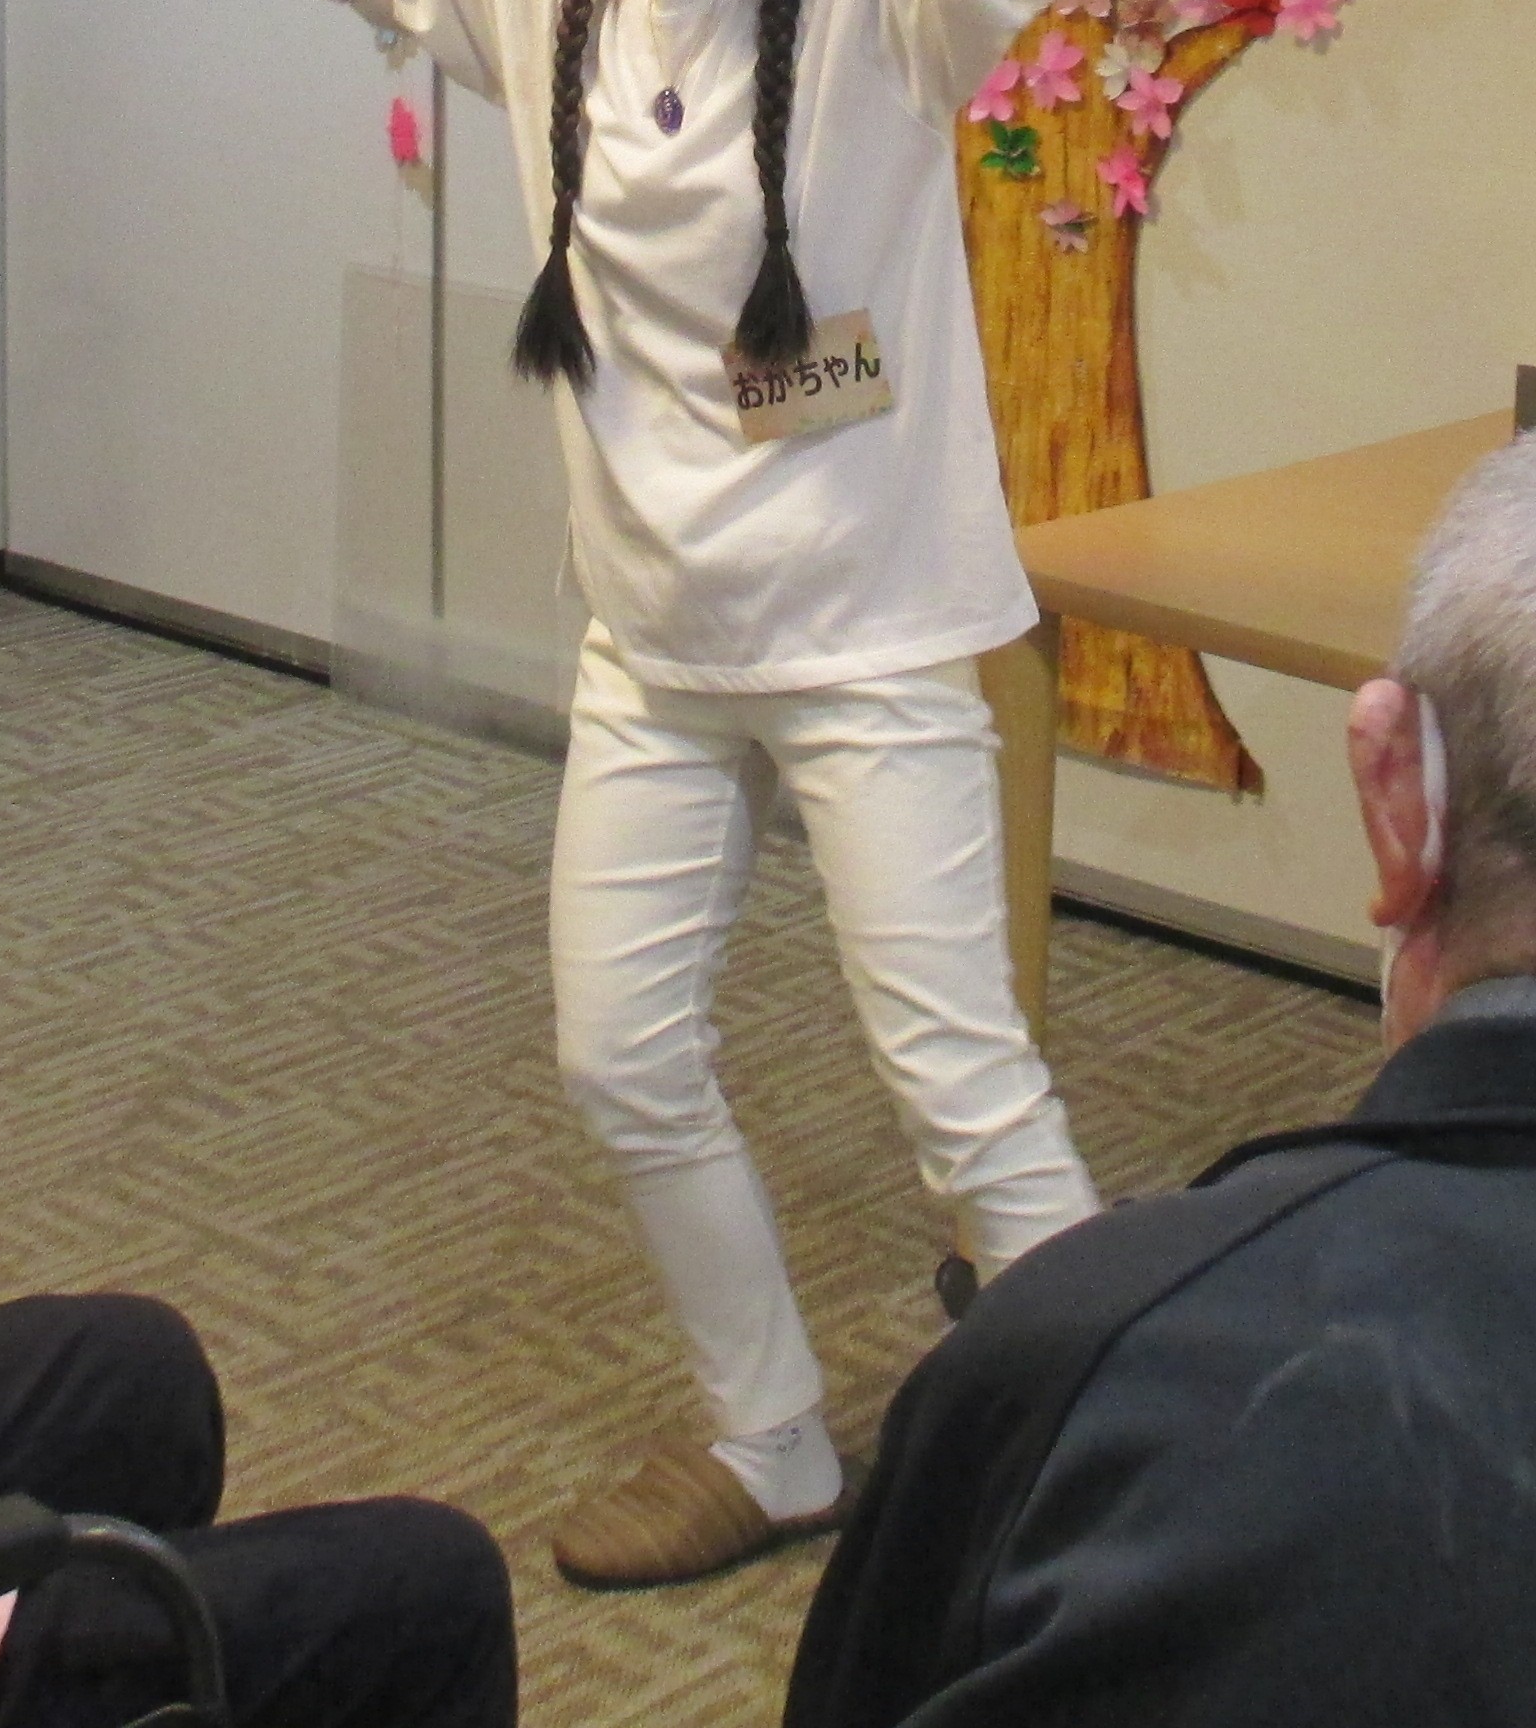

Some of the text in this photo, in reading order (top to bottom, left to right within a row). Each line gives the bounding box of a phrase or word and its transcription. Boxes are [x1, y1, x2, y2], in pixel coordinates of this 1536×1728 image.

[733, 342, 880, 410] おかちゃん
